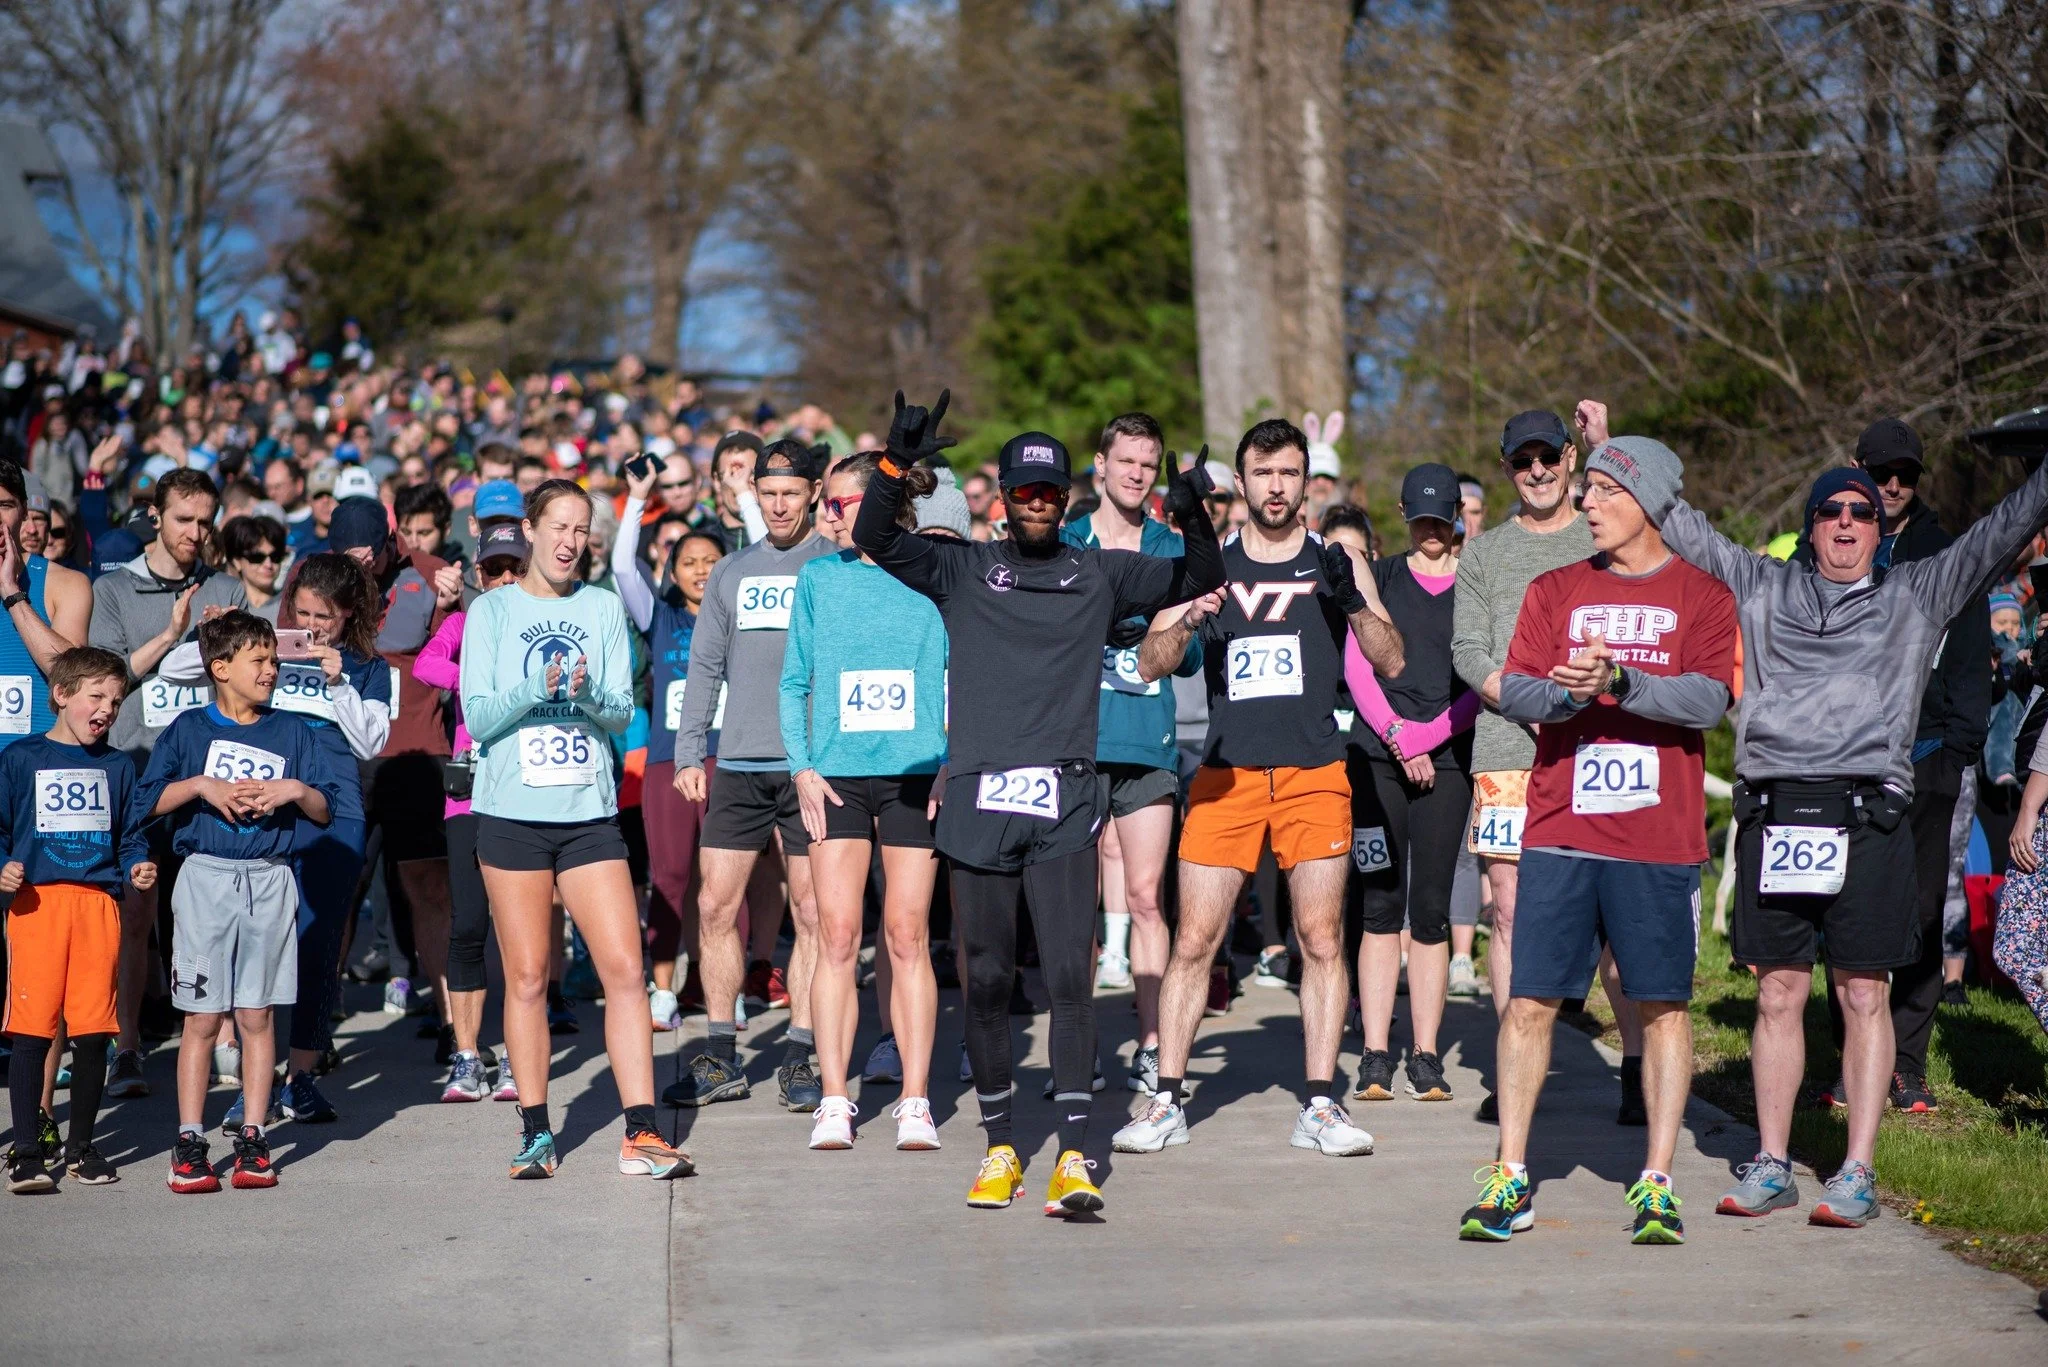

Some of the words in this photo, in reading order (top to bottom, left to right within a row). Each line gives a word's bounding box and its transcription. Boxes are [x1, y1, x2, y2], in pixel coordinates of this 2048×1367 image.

[1423, 487, 1436, 496] OR
[743, 586, 796, 611] 360
[1230, 581, 1317, 622] VT
[519, 620, 555, 644] BULL
[558, 620, 589, 642] CITY
[1569, 604, 1678, 645] GHP
[1234, 647, 1294, 680] 278
[1630, 648, 1671, 665] TEAM
[529, 706, 559, 718] TRACK
[560, 706, 584, 718] CLUB
[847, 683, 906, 711] 439
[528, 735, 589, 766] 335
[1478, 774, 1502, 798] NIKE
[1581, 758, 1650, 791] 201
[44, 781, 105, 812] 381
[986, 772, 1051, 810] 222
[1770, 839, 1838, 872] 262
